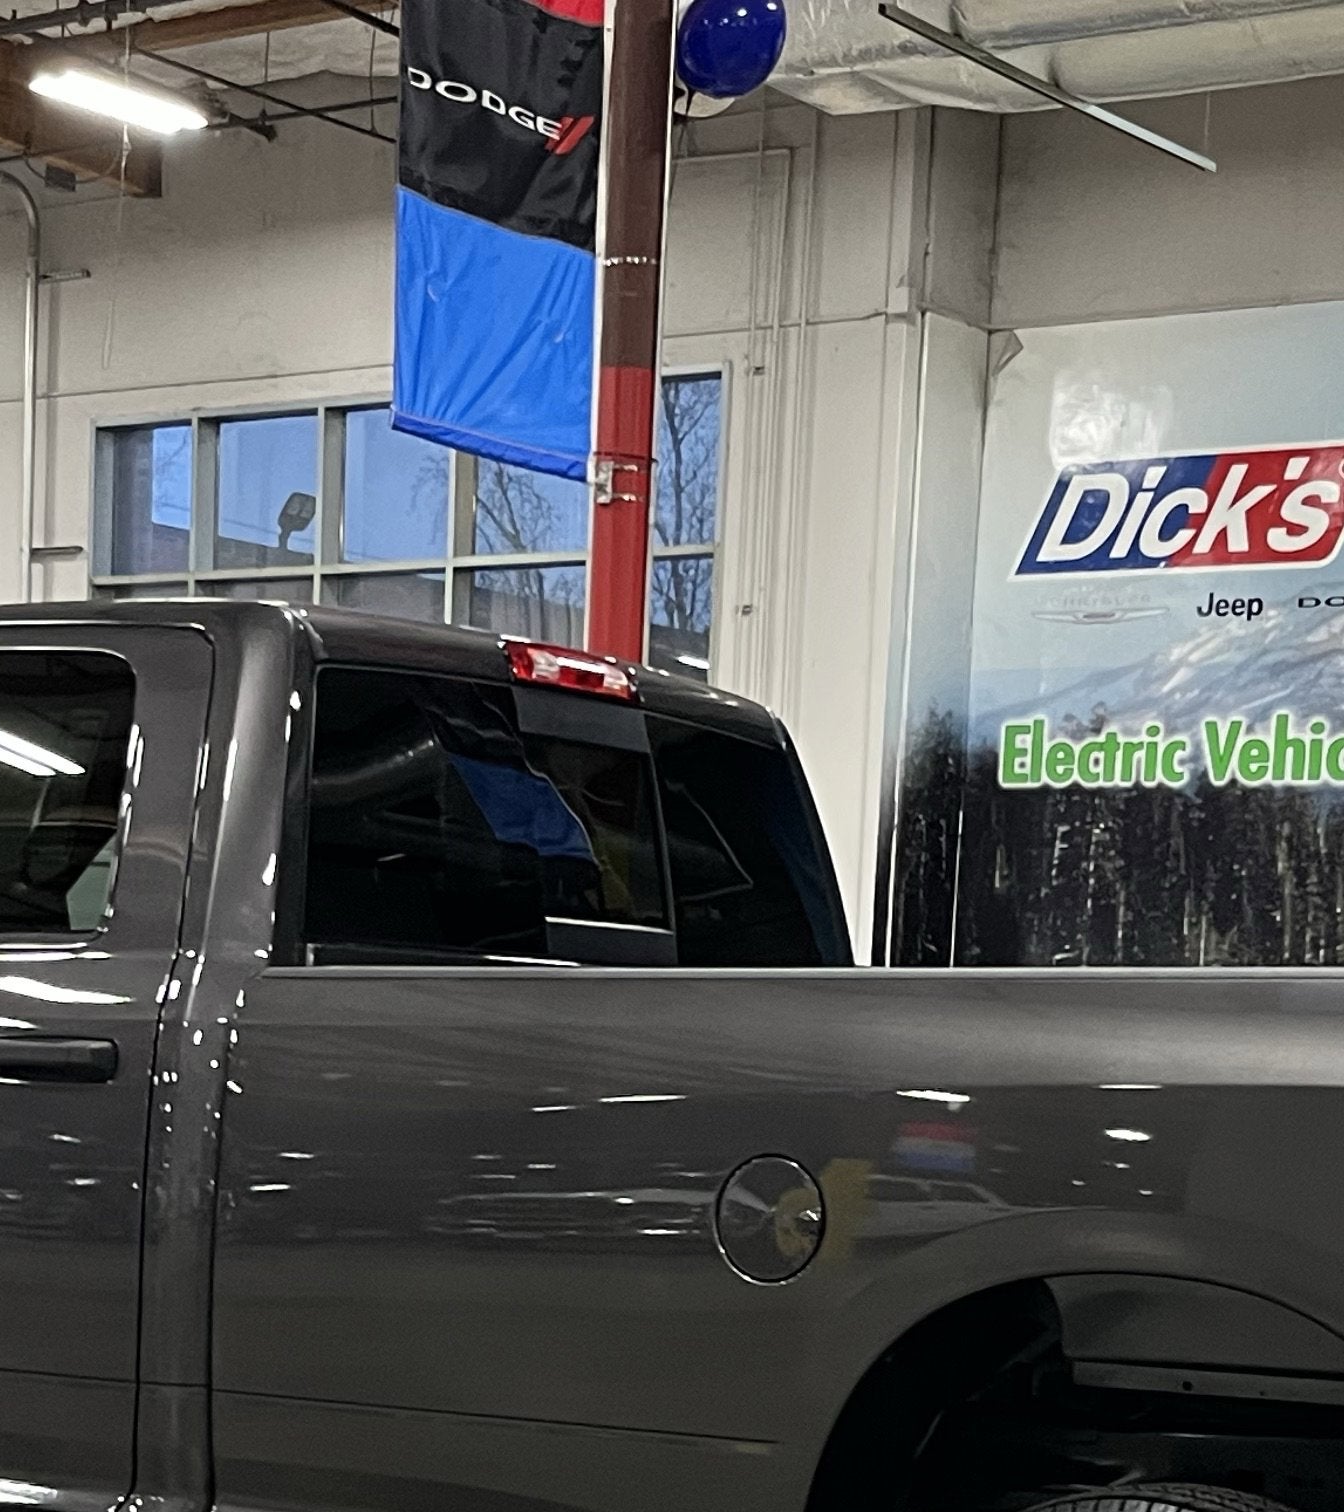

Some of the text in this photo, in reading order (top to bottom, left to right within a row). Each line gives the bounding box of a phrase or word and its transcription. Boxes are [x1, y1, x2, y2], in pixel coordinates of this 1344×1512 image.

[408, 66, 562, 141] DODGE
[1036, 456, 1341, 562] Dick's
[1196, 592, 1264, 621] Jeep
[1001, 718, 1187, 784] Electric
